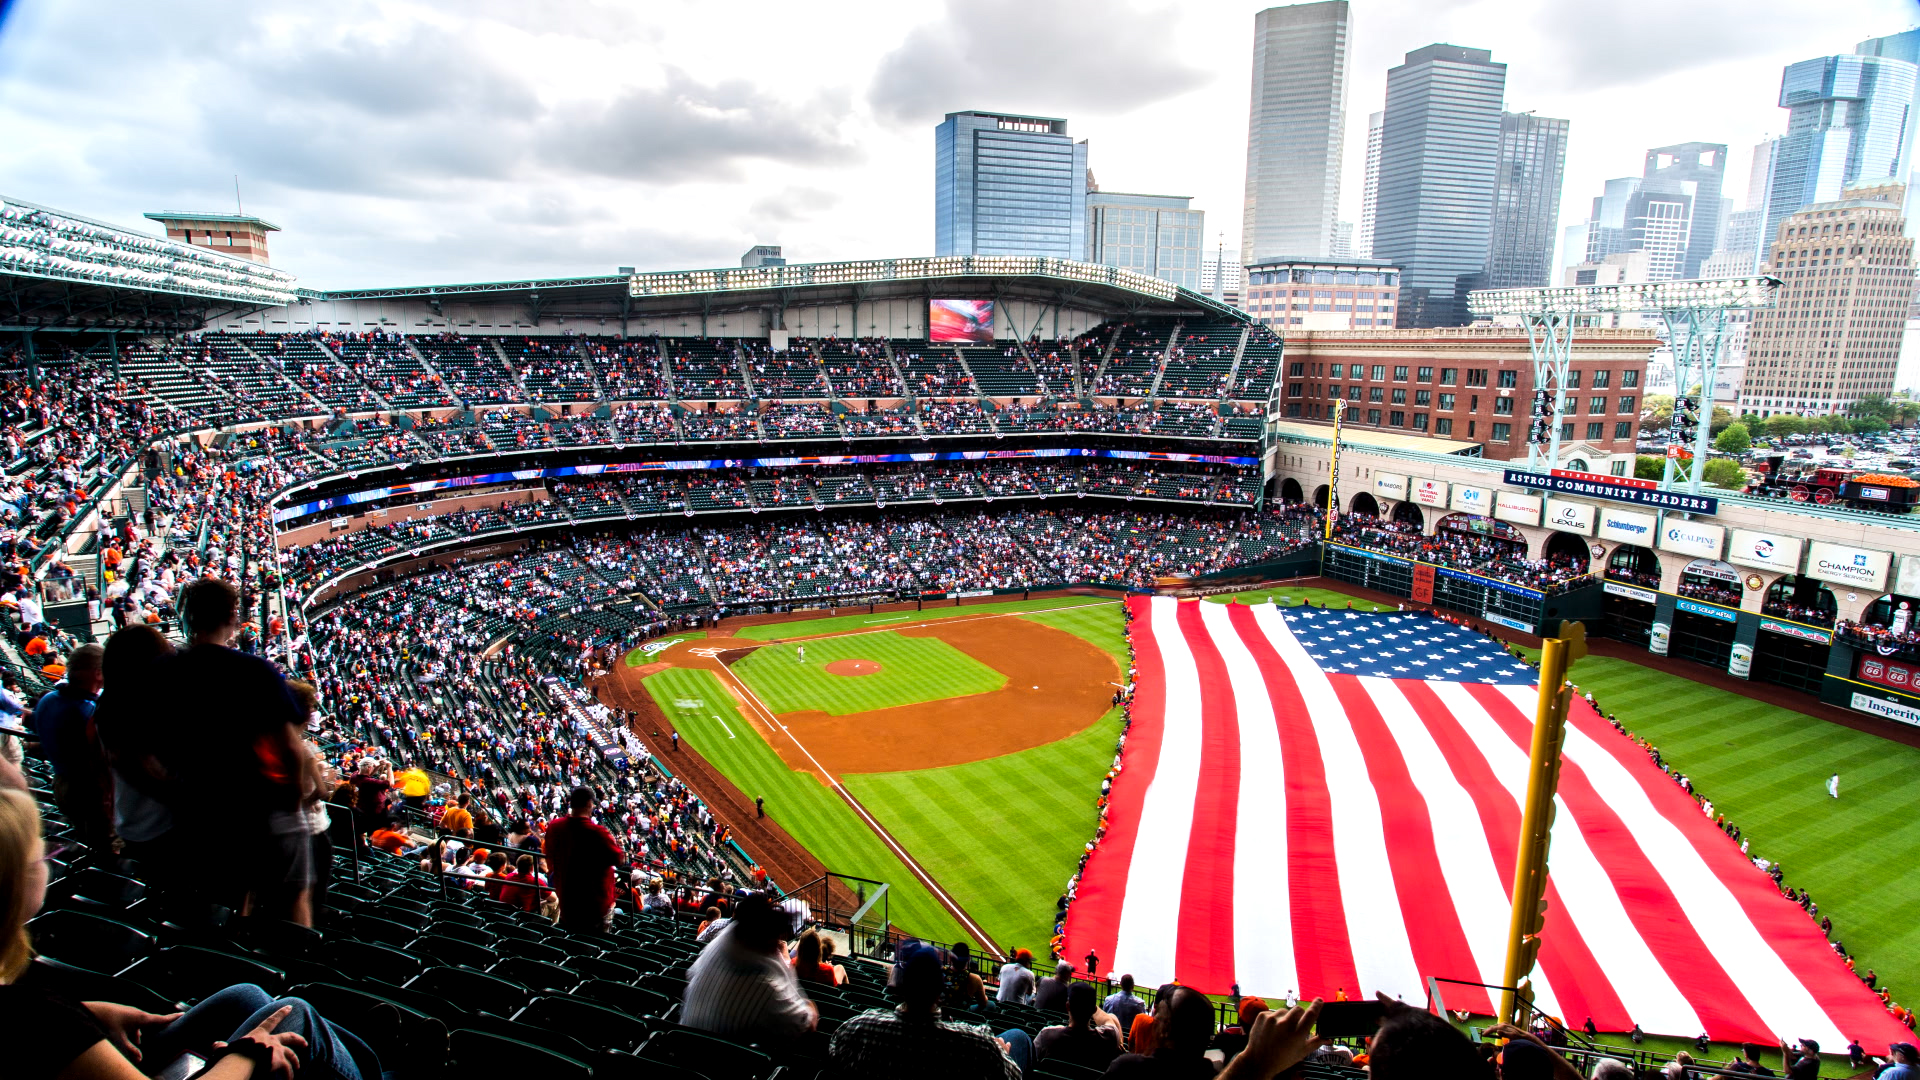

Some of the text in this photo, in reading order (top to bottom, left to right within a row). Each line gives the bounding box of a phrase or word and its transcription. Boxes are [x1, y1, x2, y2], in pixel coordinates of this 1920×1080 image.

[1560, 471, 1647, 487] MINUTE MAID
[1509, 473, 1708, 510] ASTROS COMMUNITY LEADERS
[1497, 502, 1539, 514] HALLIBURTON
[1551, 517, 1585, 529] LEXUS
[1606, 518, 1647, 535] Schlumberger
[1680, 533, 1715, 545] CALPINE
[1755, 544, 1774, 553] OXY
[1818, 560, 1875, 577] CHAMPION
[1817, 568, 1873, 583] ENERGY SERVICES
[1415, 587, 1429, 598] GF
[1606, 584, 1654, 600] HOUSTON CHRONICLE
[1698, 606, 1715, 614] SCRAP
[1716, 611, 1732, 619] METAL
[1502, 618, 1524, 630] mazda
[1866, 666, 1880, 675] 66
[1890, 673, 1904, 681] 66
[1868, 699, 1920, 723] Insperity
